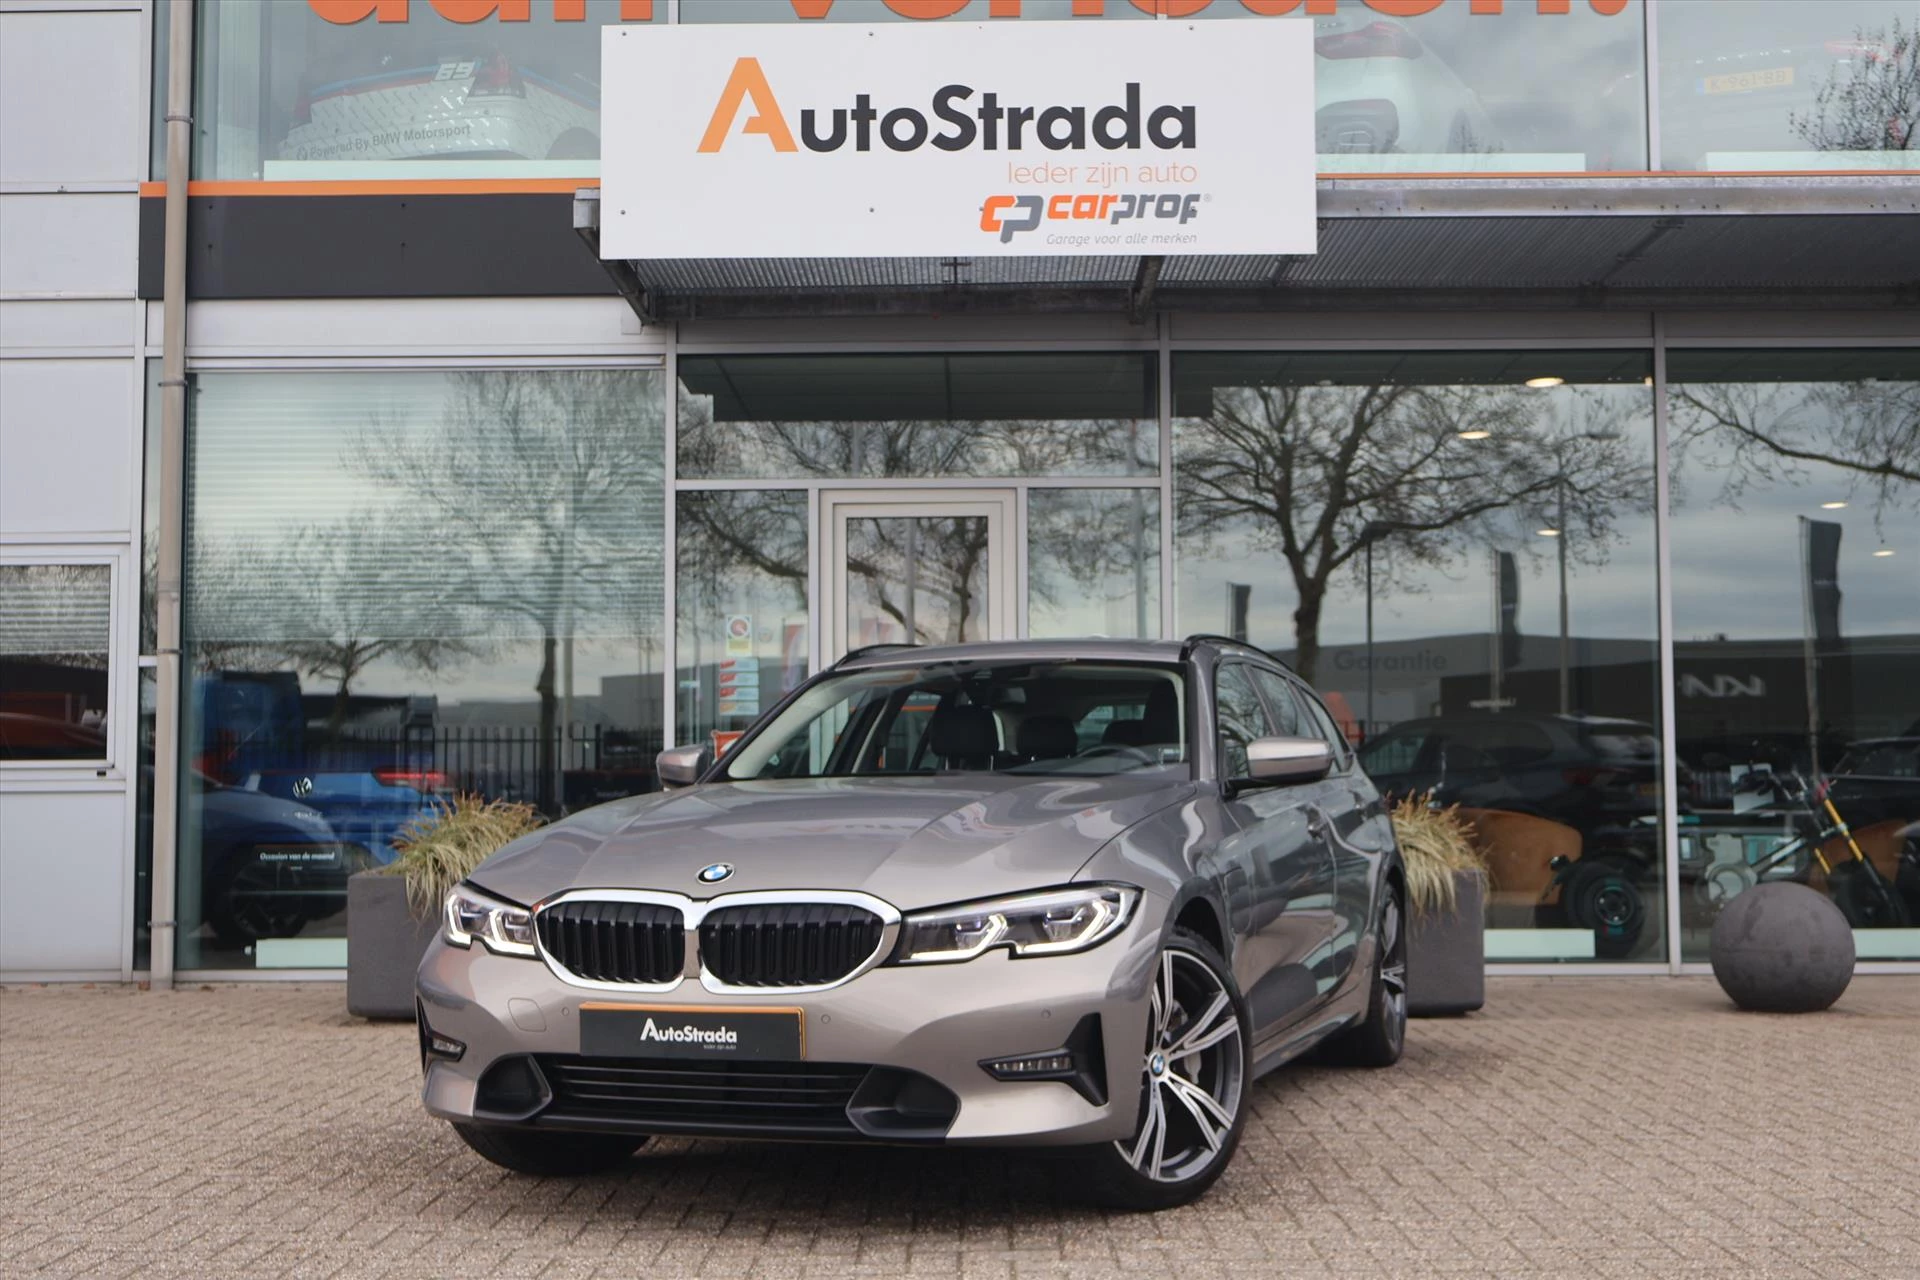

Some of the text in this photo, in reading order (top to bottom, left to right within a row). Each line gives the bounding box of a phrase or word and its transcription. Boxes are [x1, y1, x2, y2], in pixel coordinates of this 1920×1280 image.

[438, 61, 474, 81] 69
[696, 57, 1197, 154] AutoStrada
[310, 124, 472, 157] Powered By BMW Motorsport
[1008, 161, 1198, 188] Ieder zijn auto
[1047, 193, 1201, 225] carprof
[1046, 232, 1198, 245] Garage voor alle merken
[1334, 649, 1447, 671] Garantie
[640, 1017, 738, 1044] AutoStrada
